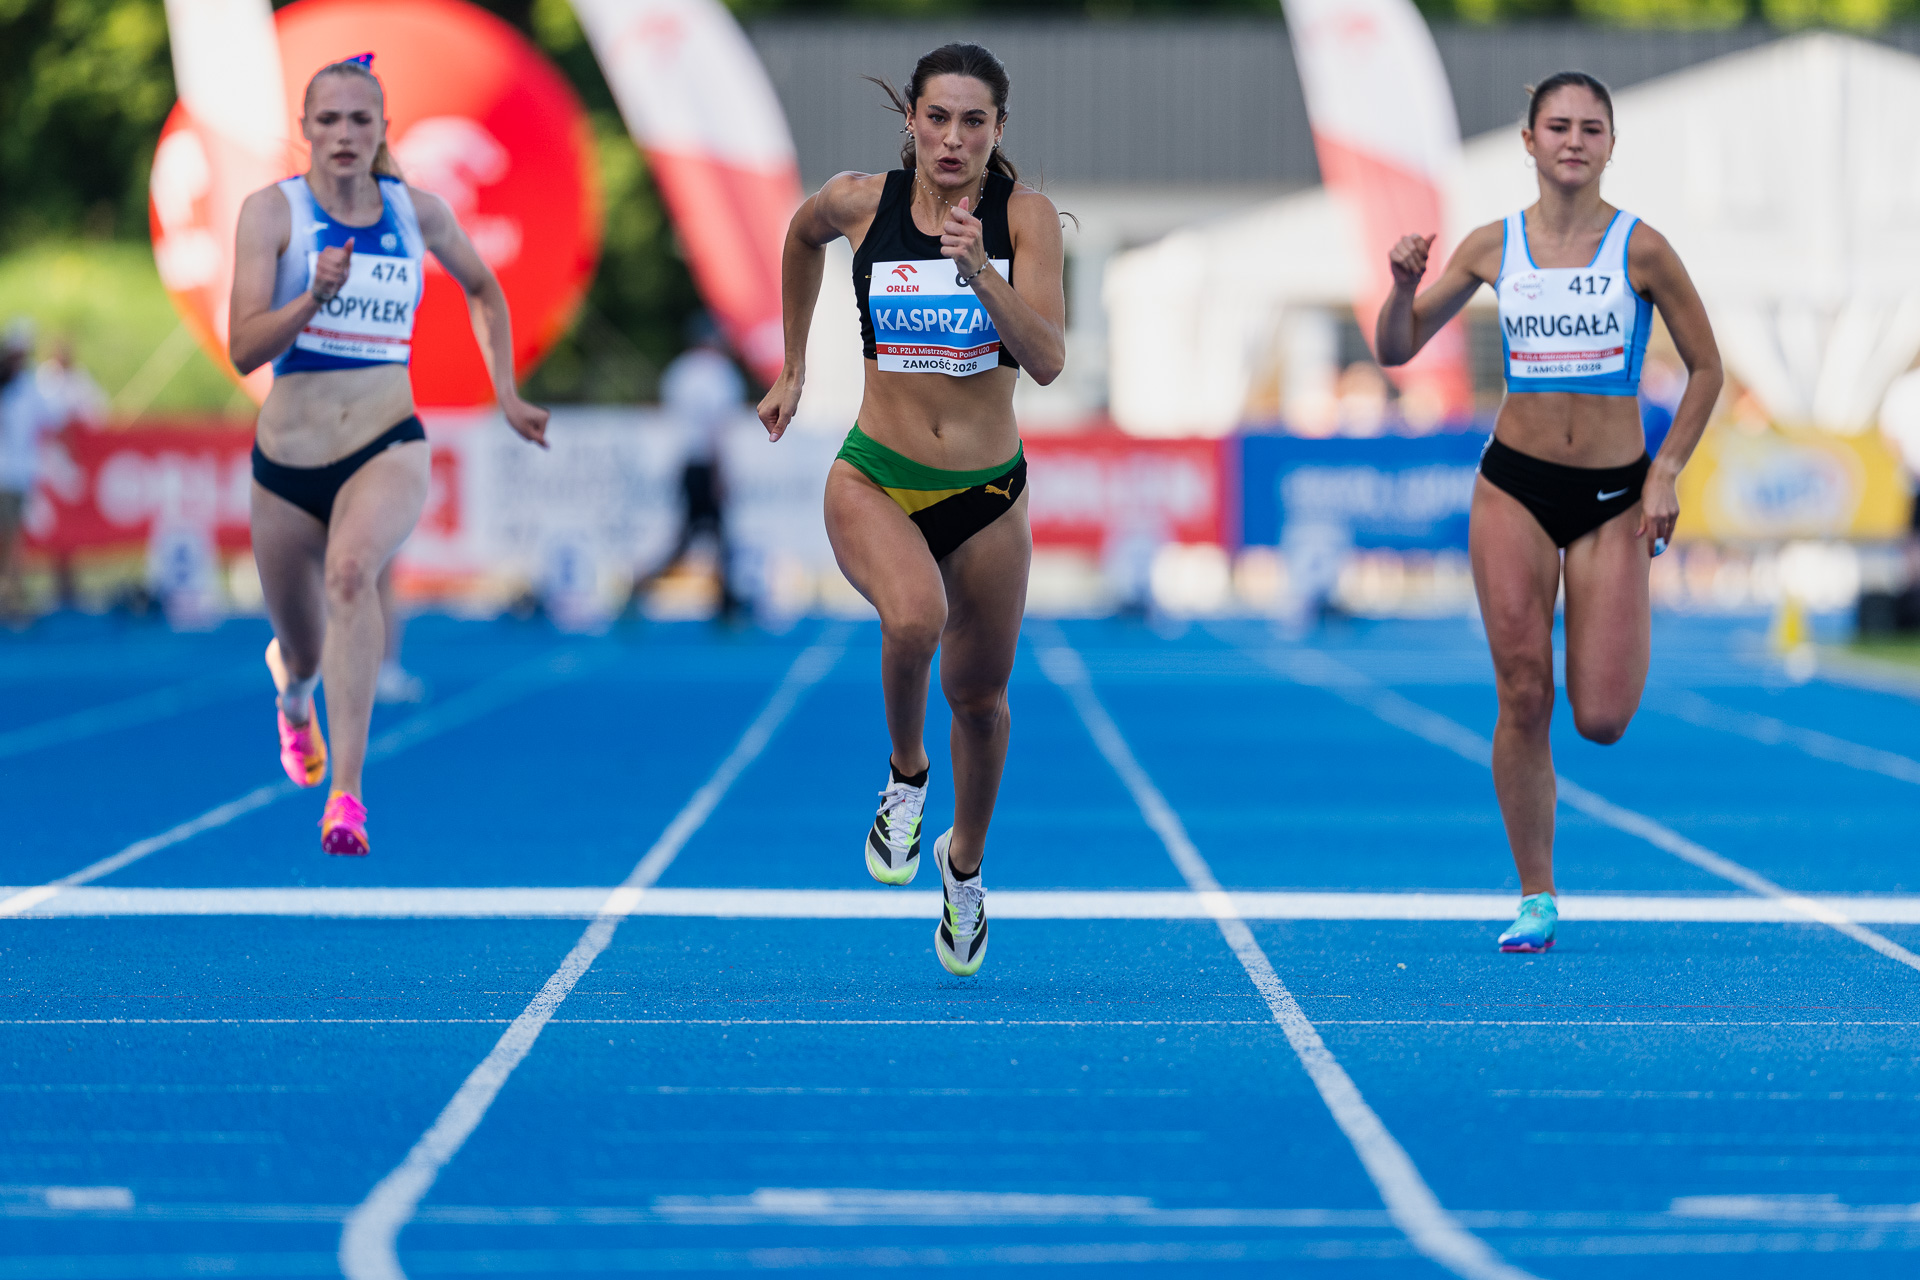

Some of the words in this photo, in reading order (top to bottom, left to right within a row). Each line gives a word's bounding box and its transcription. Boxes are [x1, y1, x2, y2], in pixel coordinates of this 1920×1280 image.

[371, 262, 408, 283] 474
[886, 285, 920, 293] ORLEN
[1568, 275, 1611, 295] 417
[319, 295, 409, 325] OPYŁEK
[1504, 312, 1620, 339] MRUGAŁA
[887, 346, 899, 354] 80.
[900, 347, 917, 355] PZLA
[918, 347, 958, 358] Mistrzostwa
[959, 349, 979, 359] Polski
[978, 345, 990, 355] U20
[902, 358, 951, 371] ZAMOŚĆ
[952, 361, 978, 372] 2026
